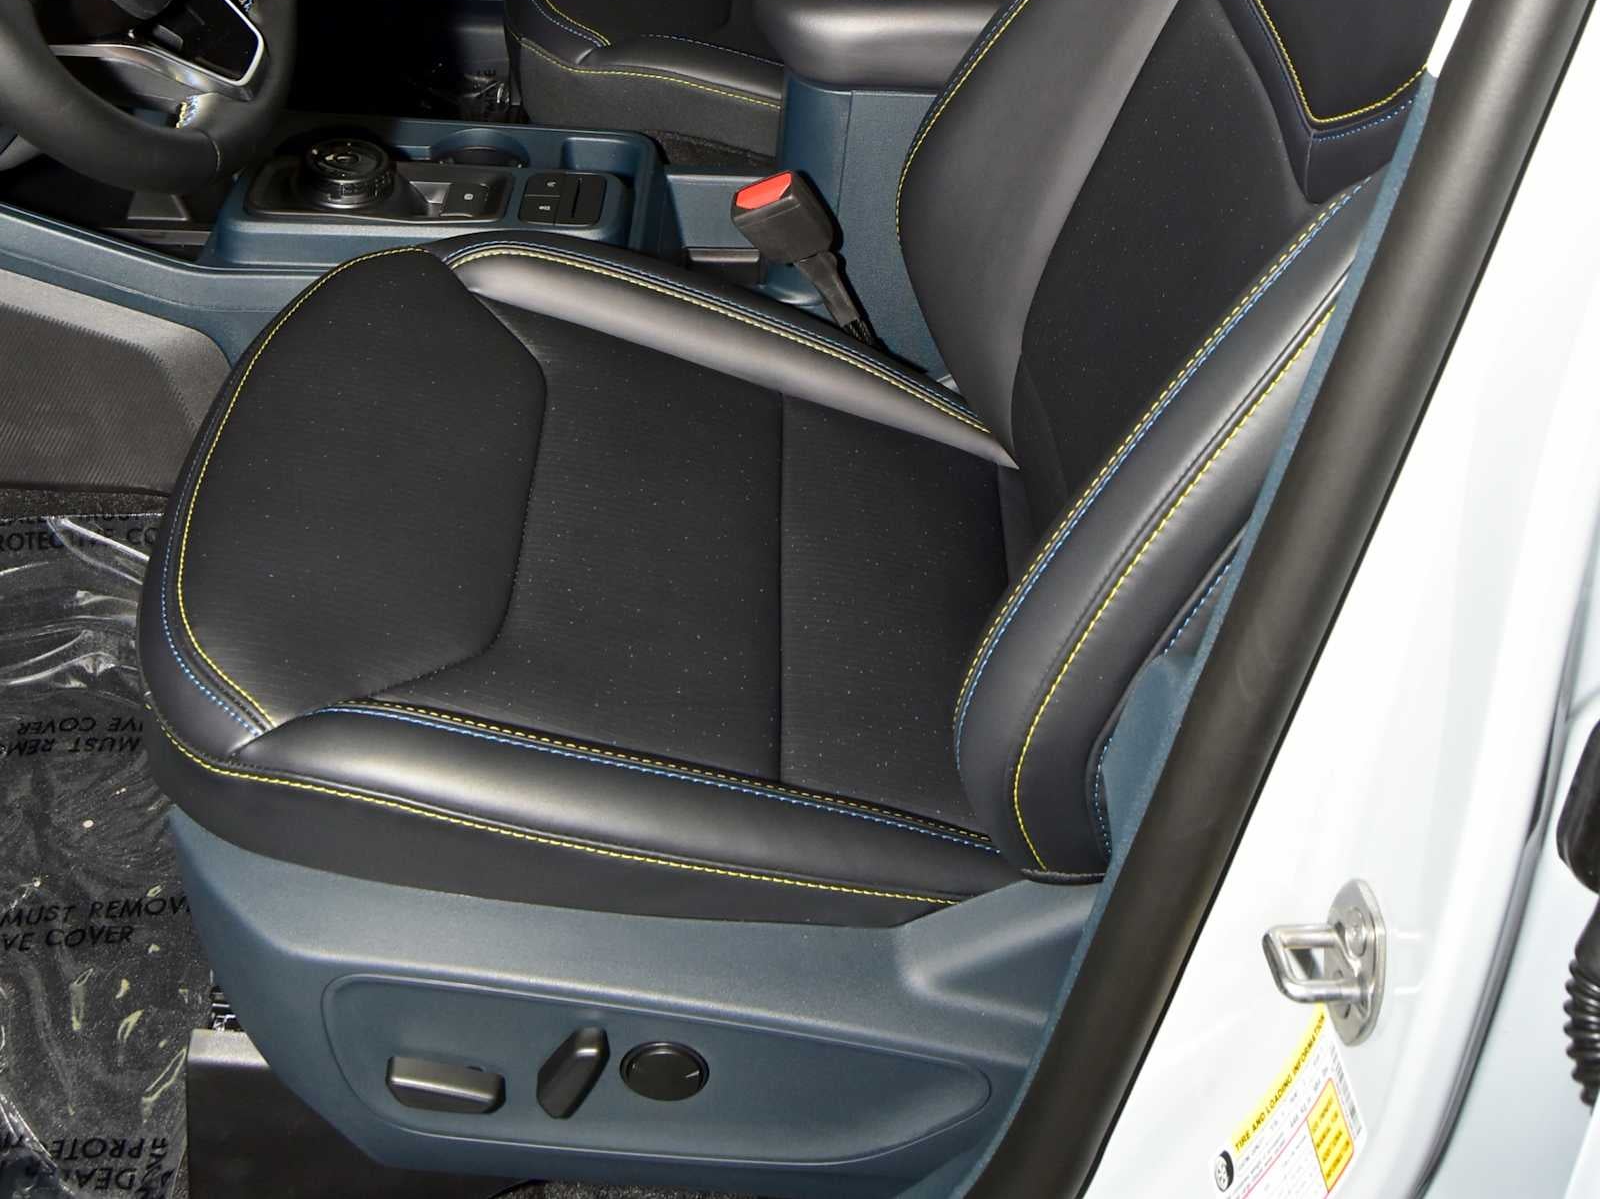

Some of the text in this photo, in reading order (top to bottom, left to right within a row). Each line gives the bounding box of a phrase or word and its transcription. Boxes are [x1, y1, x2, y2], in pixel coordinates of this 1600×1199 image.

[17, 717, 97, 735] COVER
[68, 737, 141, 753] MUST
[0, 905, 76, 927] MUST
[44, 925, 134, 948] COVER
